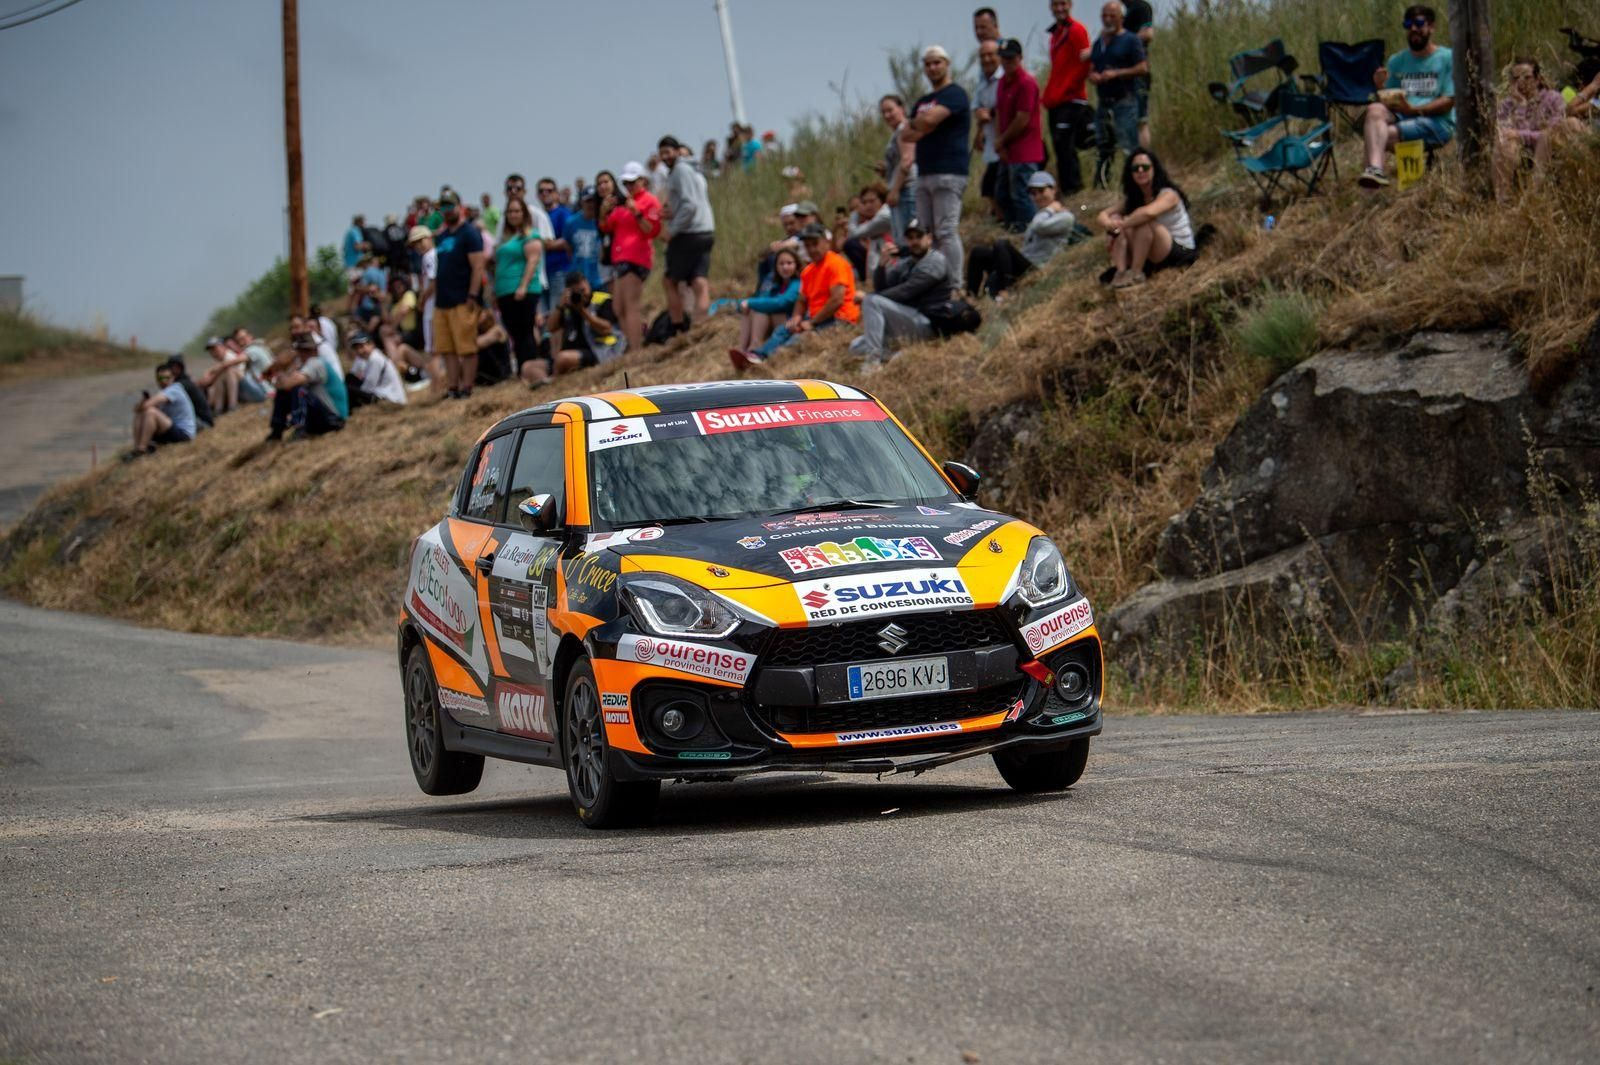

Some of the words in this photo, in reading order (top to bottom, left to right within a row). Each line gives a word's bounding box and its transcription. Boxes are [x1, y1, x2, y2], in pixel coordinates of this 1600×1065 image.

[705, 405, 795, 429] Suzuki
[797, 408, 862, 421] Finance
[599, 433, 643, 445] SUZUKI
[640, 531, 654, 539] E
[770, 526, 839, 540] Concello
[498, 544, 510, 560] La
[511, 545, 535, 567] Región
[578, 555, 617, 593] Cruce
[834, 579, 966, 603] SUZUKI
[810, 608, 837, 619] RED
[841, 606, 858, 615] DE
[861, 596, 974, 612] CONCESIONARIOS
[1040, 602, 1090, 637] ourense
[1051, 622, 1080, 644] provincia
[656, 642, 747, 671] ourense
[664, 657, 710, 674] provincia
[713, 666, 747, 682] termal
[863, 669, 907, 691] 2696
[912, 664, 946, 686] KVJ
[602, 694, 628, 706] REDUR
[853, 686, 859, 694] E
[499, 692, 549, 734] MOTUL
[605, 712, 629, 723] MOTUL
[838, 723, 958, 741] www.suzuki.es
